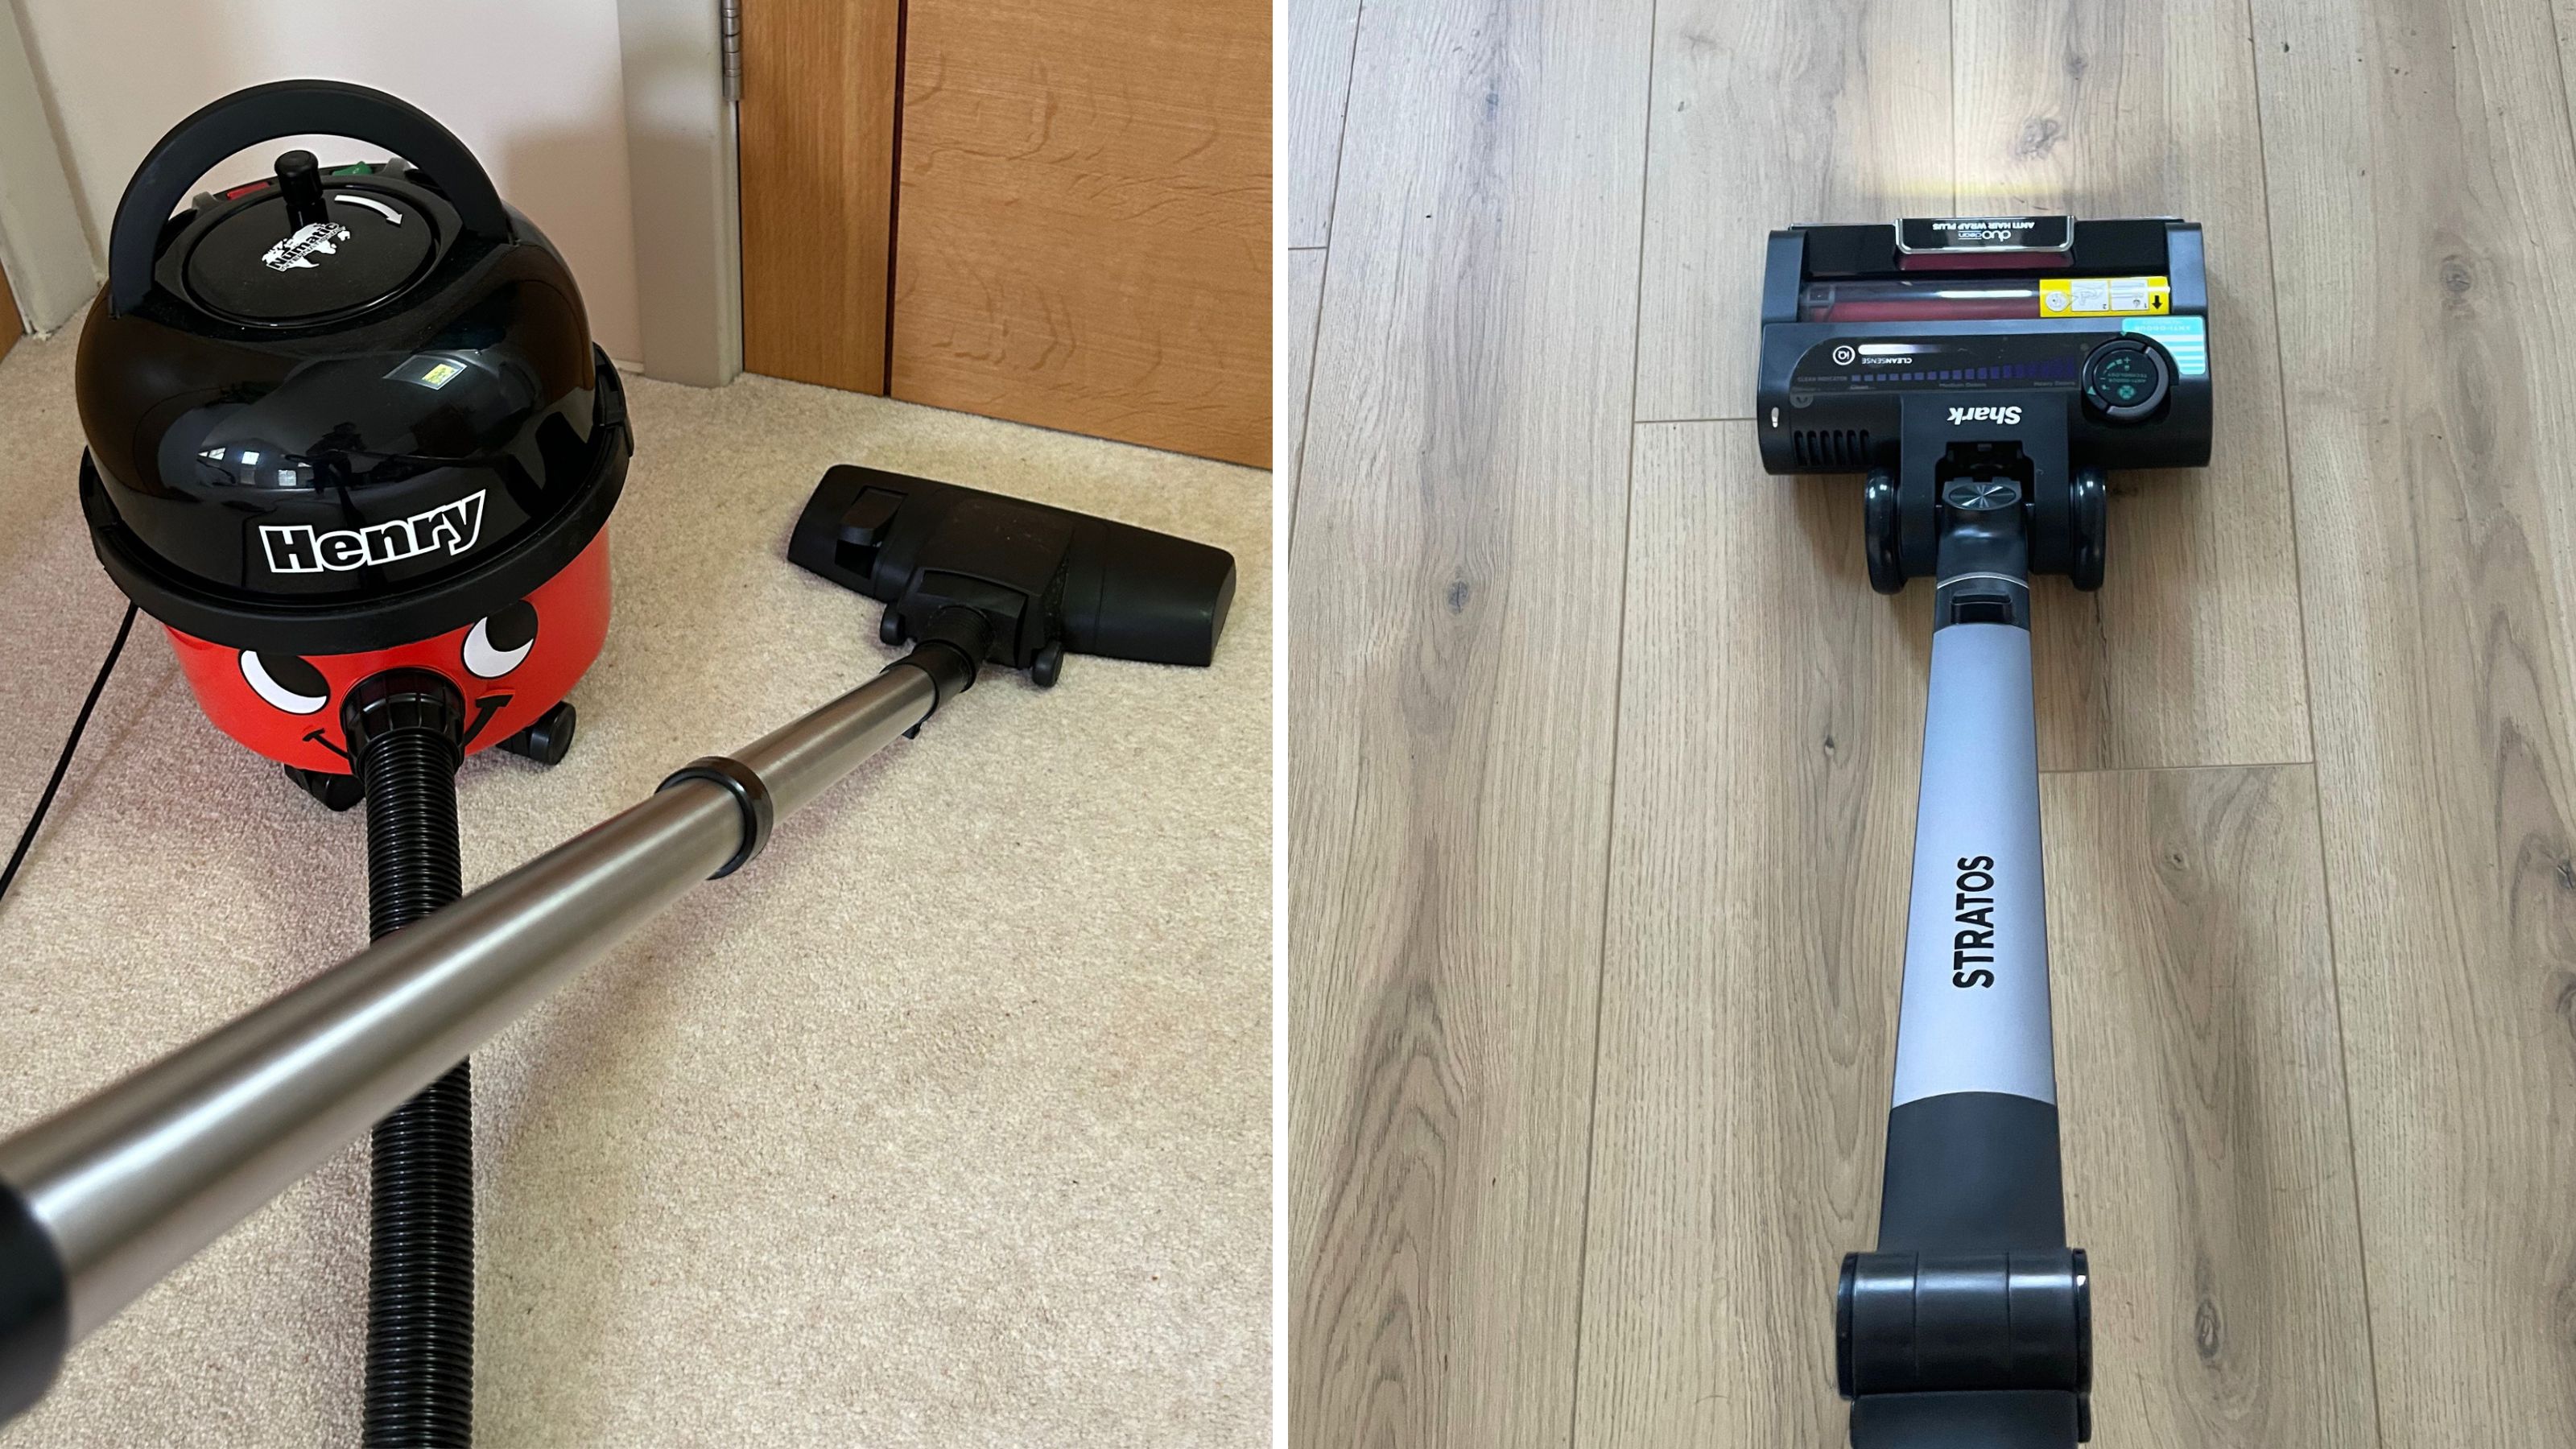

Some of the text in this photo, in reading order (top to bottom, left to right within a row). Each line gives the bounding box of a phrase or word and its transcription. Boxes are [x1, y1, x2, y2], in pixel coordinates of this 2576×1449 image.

[1932, 222, 2035, 230] ANTI HAIR WRAP PLUS
[268, 223, 339, 269] Numatic
[1861, 356, 1913, 365] CLEANSENSE
[1946, 406, 2022, 425] Shark
[258, 489, 486, 573] Henry
[1952, 856, 1995, 989] STRATOS
